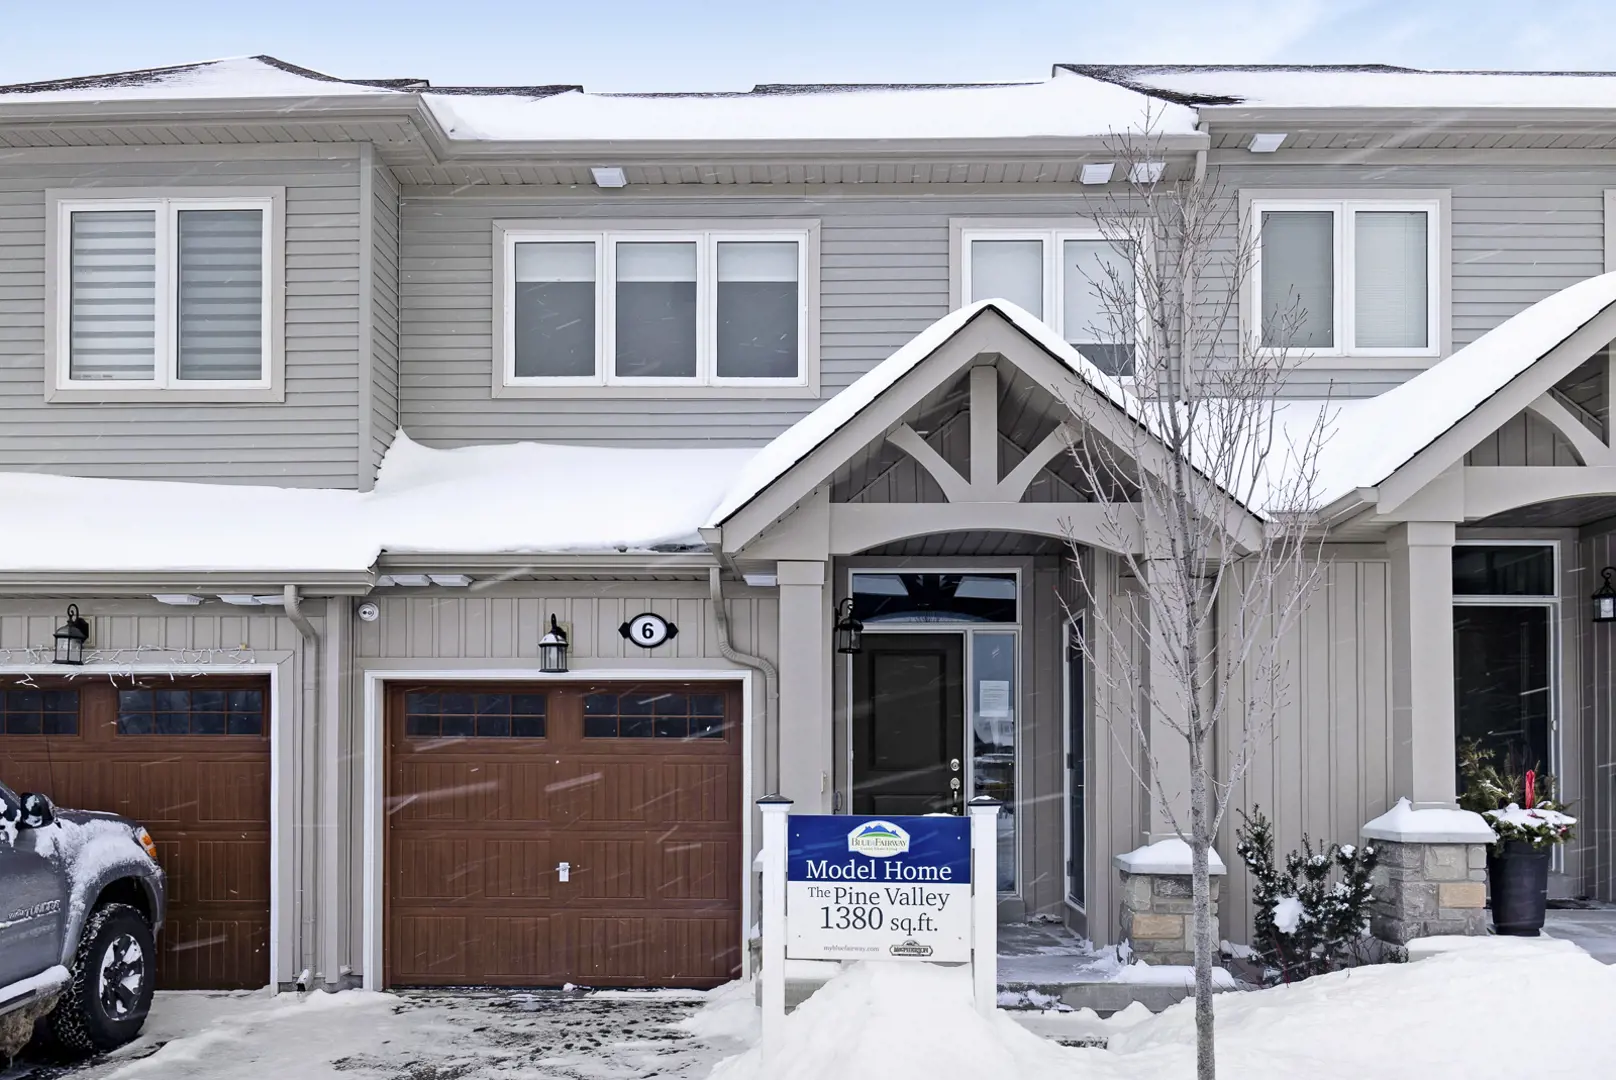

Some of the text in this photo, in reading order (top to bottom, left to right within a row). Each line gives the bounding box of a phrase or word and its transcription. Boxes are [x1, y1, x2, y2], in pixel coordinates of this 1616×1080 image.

[641, 622, 654, 639] 6
[875, 838, 907, 847] FAIRWAY
[806, 859, 952, 881] Model Home
[808, 887, 950, 911] The Pine Valley
[821, 906, 938, 936] 1380 sq.ft.
